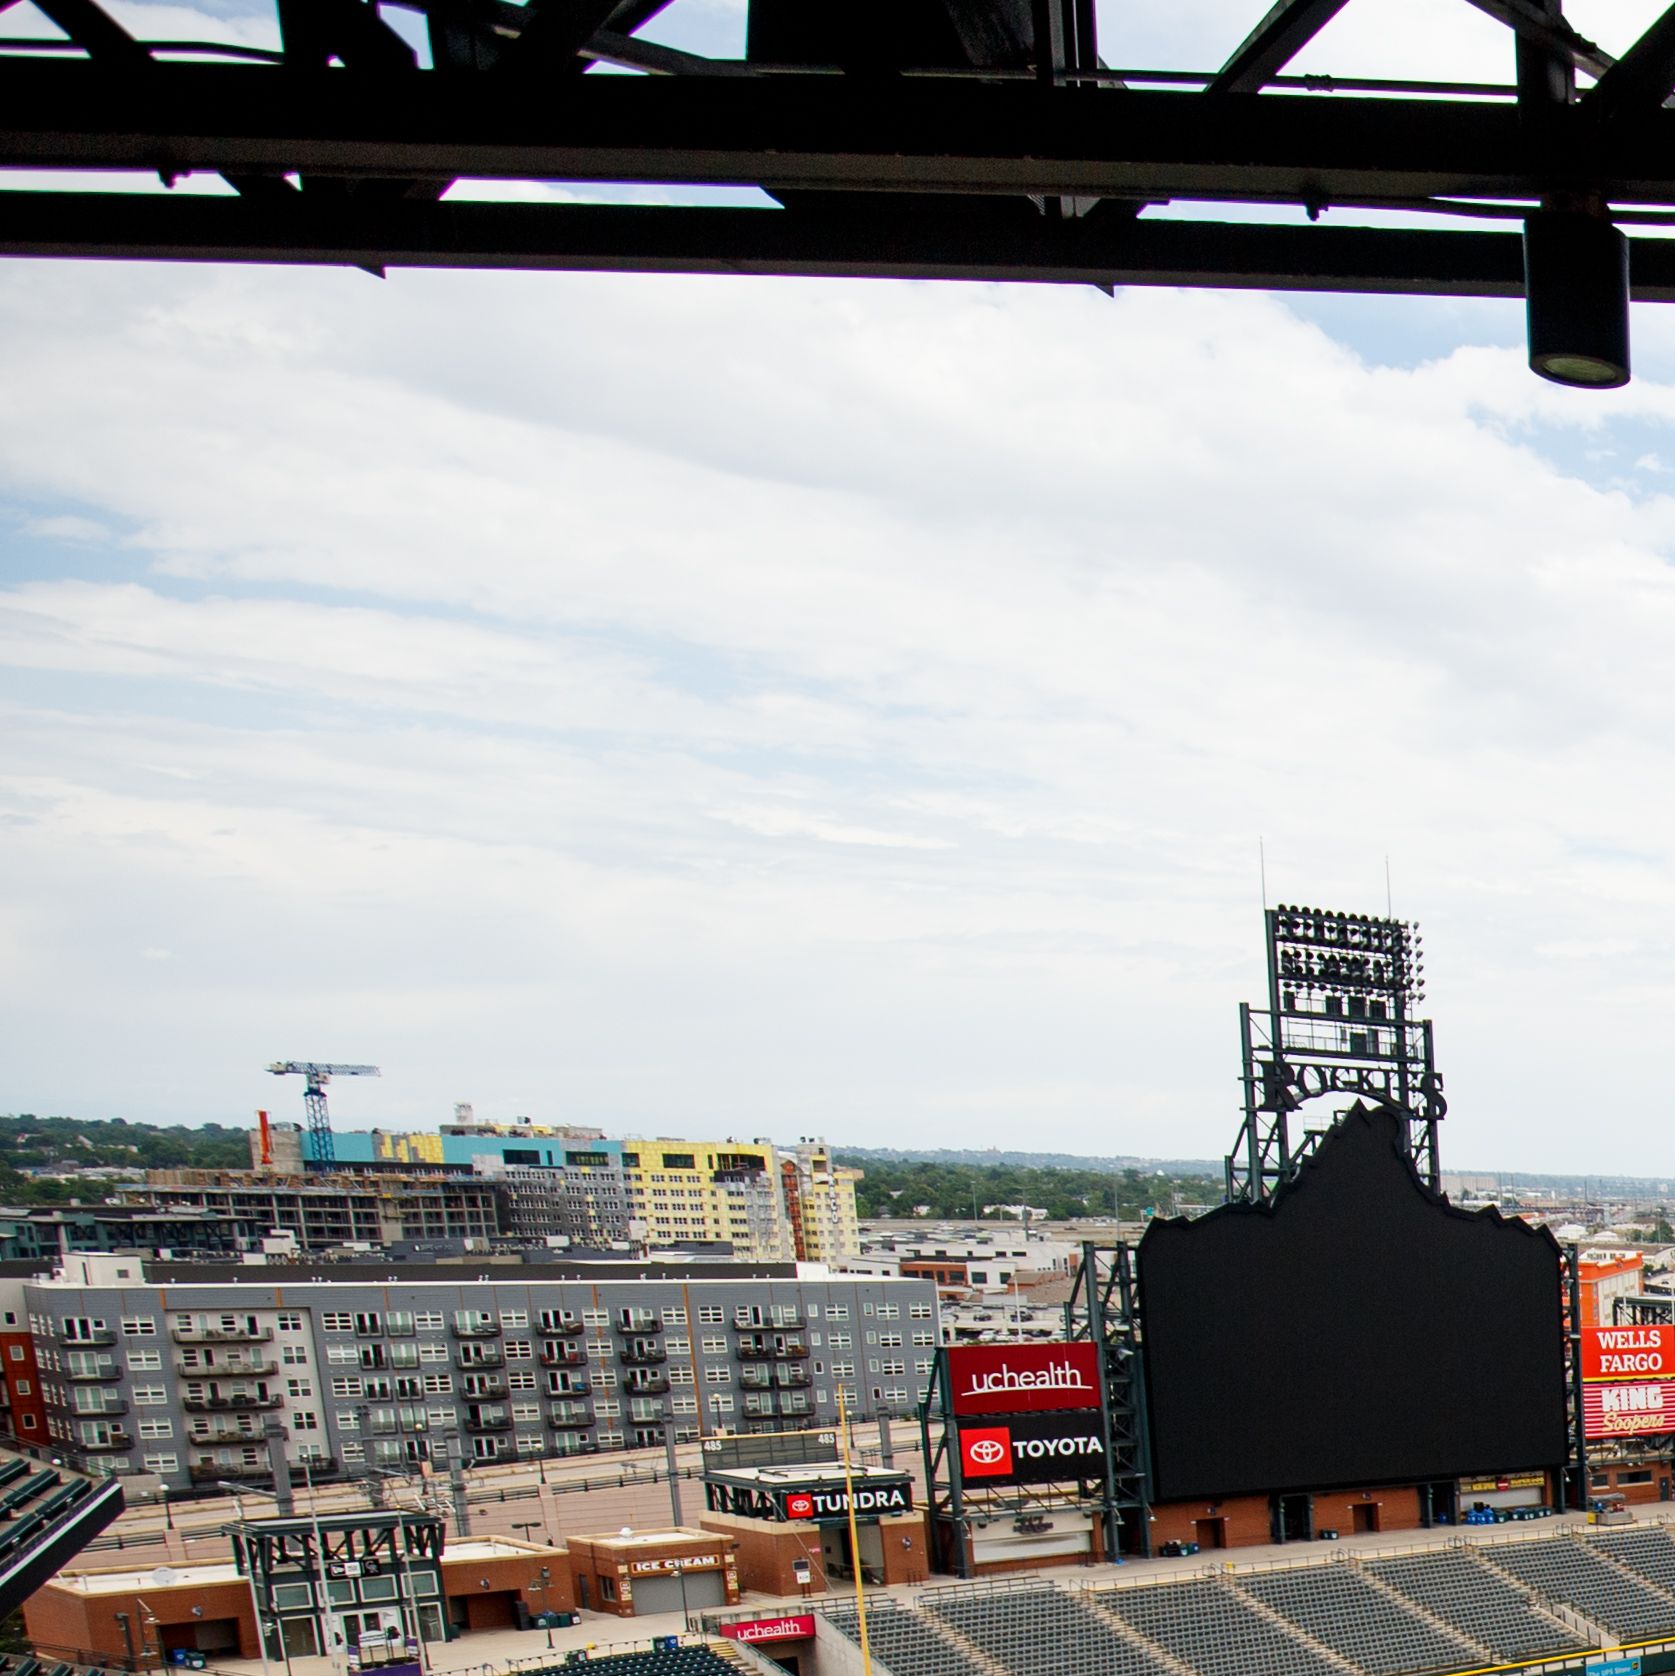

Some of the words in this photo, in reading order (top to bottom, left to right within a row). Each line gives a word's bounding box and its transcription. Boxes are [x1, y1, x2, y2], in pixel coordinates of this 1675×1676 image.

[1597, 1330, 1661, 1349] WELLS
[1600, 1353, 1662, 1372] FARGO
[972, 1361, 1082, 1392] uchealth
[1602, 1386, 1664, 1412] KING
[1602, 1411, 1665, 1435] Soopers
[704, 1440, 722, 1451] 485
[818, 1433, 835, 1444] 485
[1012, 1436, 1104, 1459] TOYOTA
[812, 1489, 905, 1513] TUNDRA
[636, 1561, 660, 1572] ICE
[664, 1556, 716, 1569] CREAM
[736, 1619, 801, 1641] uchealth
[1602, 1668, 1614, 1676] UPS
